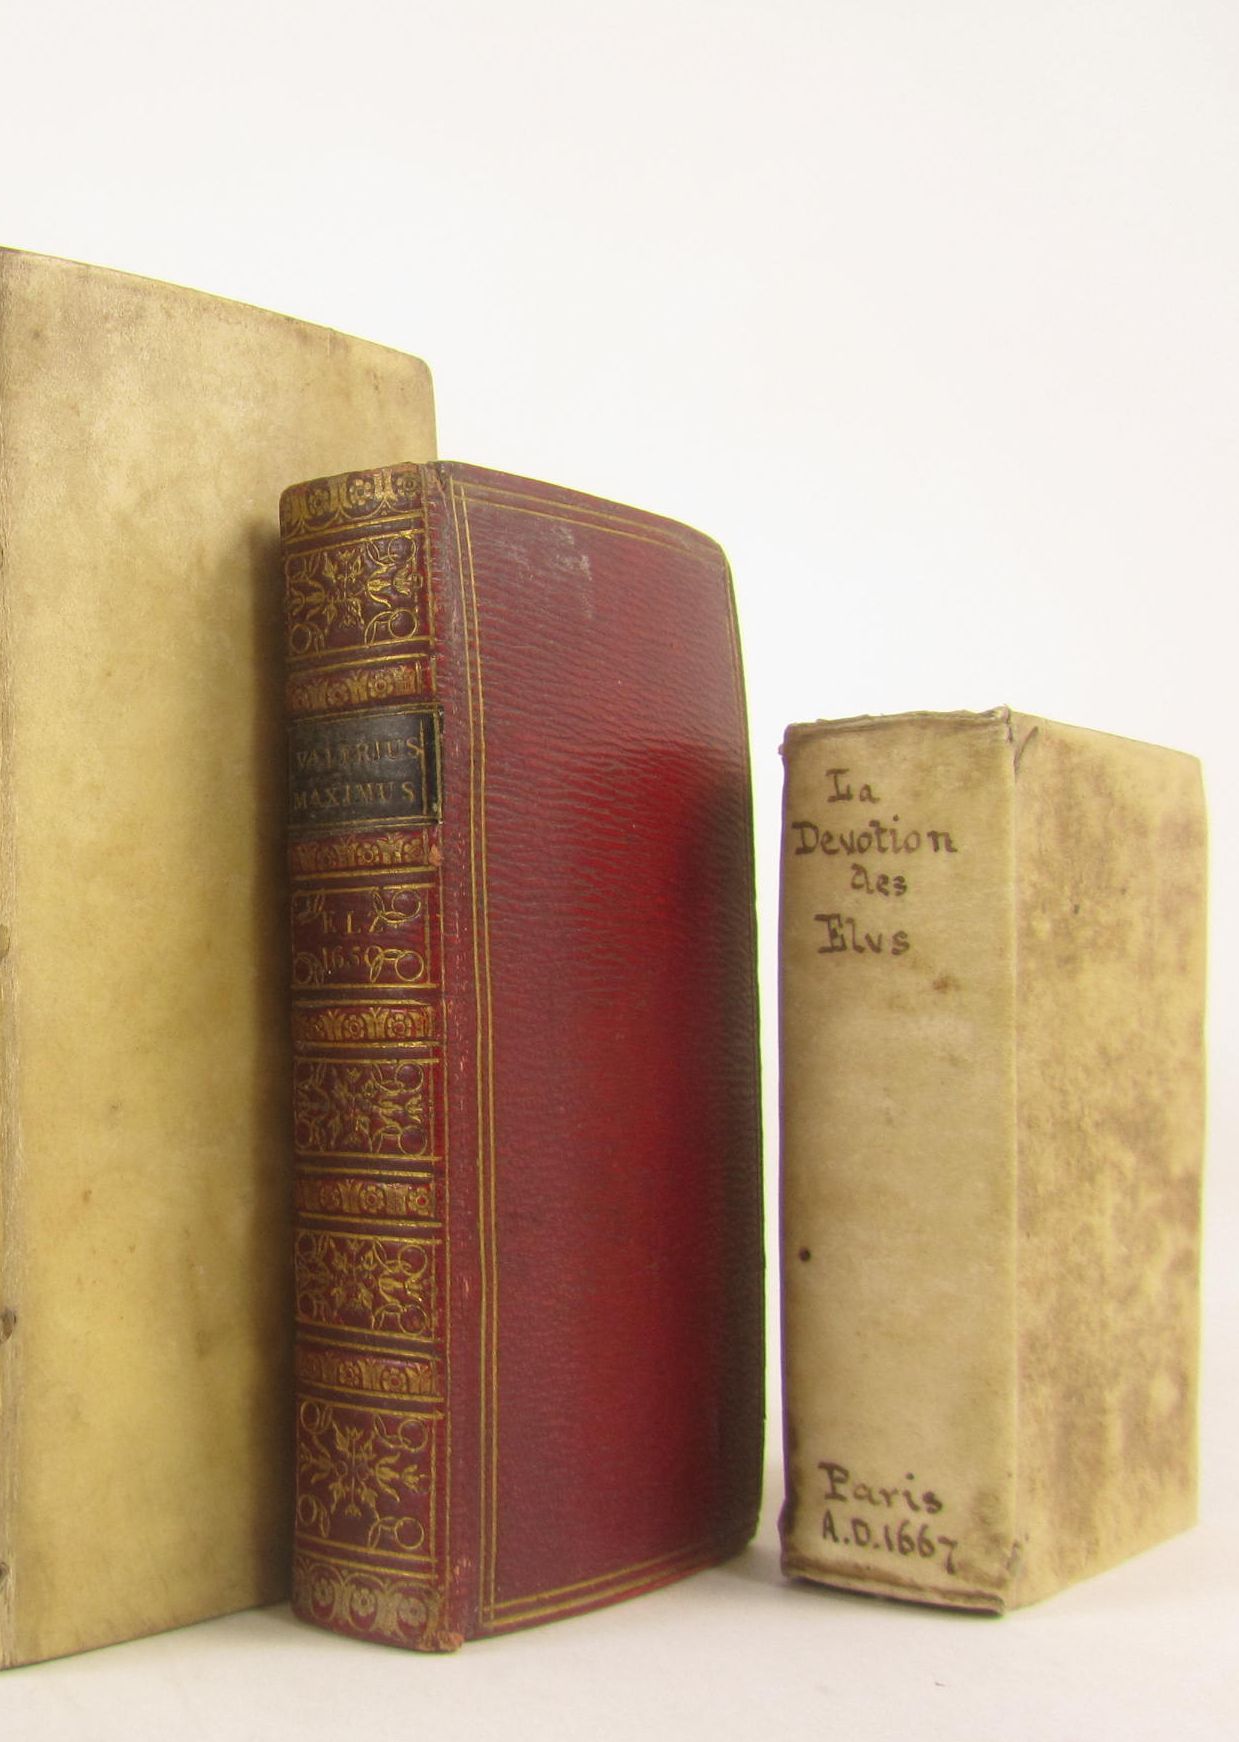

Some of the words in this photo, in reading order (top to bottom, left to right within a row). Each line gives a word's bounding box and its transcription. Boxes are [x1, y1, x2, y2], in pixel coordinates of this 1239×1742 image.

[294, 781, 417, 810] MAXIMUS
[825, 768, 880, 803] La
[791, 814, 958, 855] Devotion
[851, 863, 908, 896] des
[818, 1460, 944, 1514] Paris
[822, 1508, 958, 1575] A.D.1667
